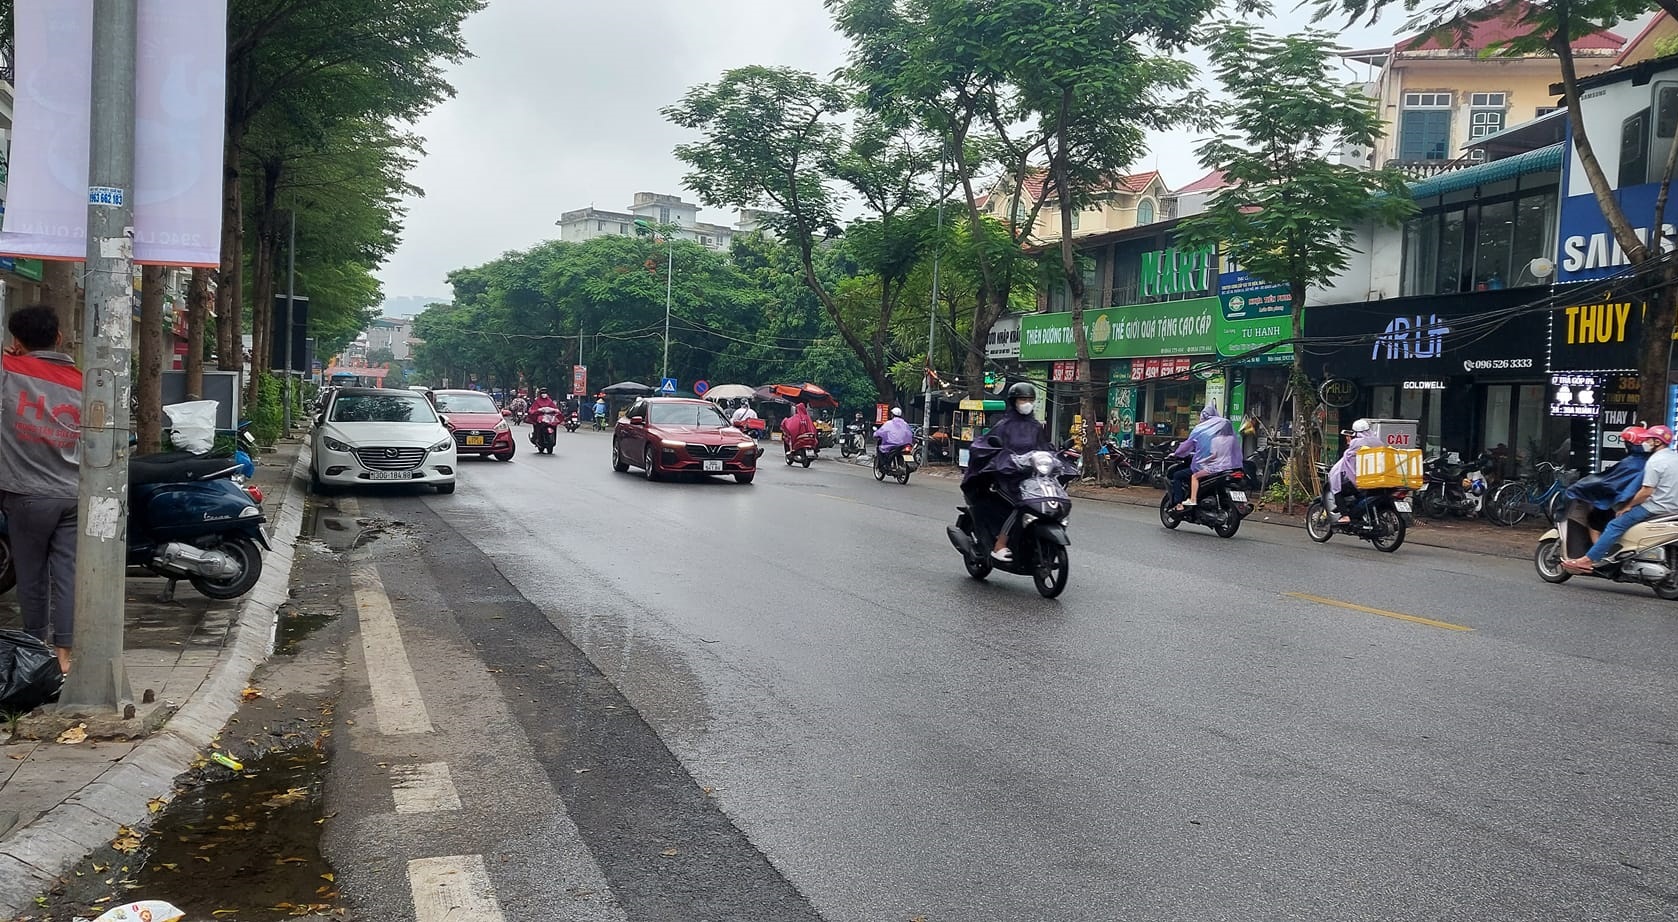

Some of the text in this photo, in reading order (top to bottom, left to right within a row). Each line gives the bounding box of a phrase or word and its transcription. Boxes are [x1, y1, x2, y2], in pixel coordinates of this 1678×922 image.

[1140, 244, 1215, 297] MART
[1112, 315, 1126, 341] THẾ
[1126, 316, 1140, 339] GIỚI
[1158, 316, 1178, 341] TẶNG
[1179, 316, 1194, 337] CAO
[1195, 308, 1212, 336] CẤP
[1566, 289, 1631, 344] THỦY
[1026, 326, 1042, 347] THIÊN
[1042, 324, 1062, 344] ĐƯỜNG
[1475, 359, 1532, 368] 096 526 3333
[1403, 381, 1446, 389] GOLDWELL
[1605, 411, 1628, 424] THAY
